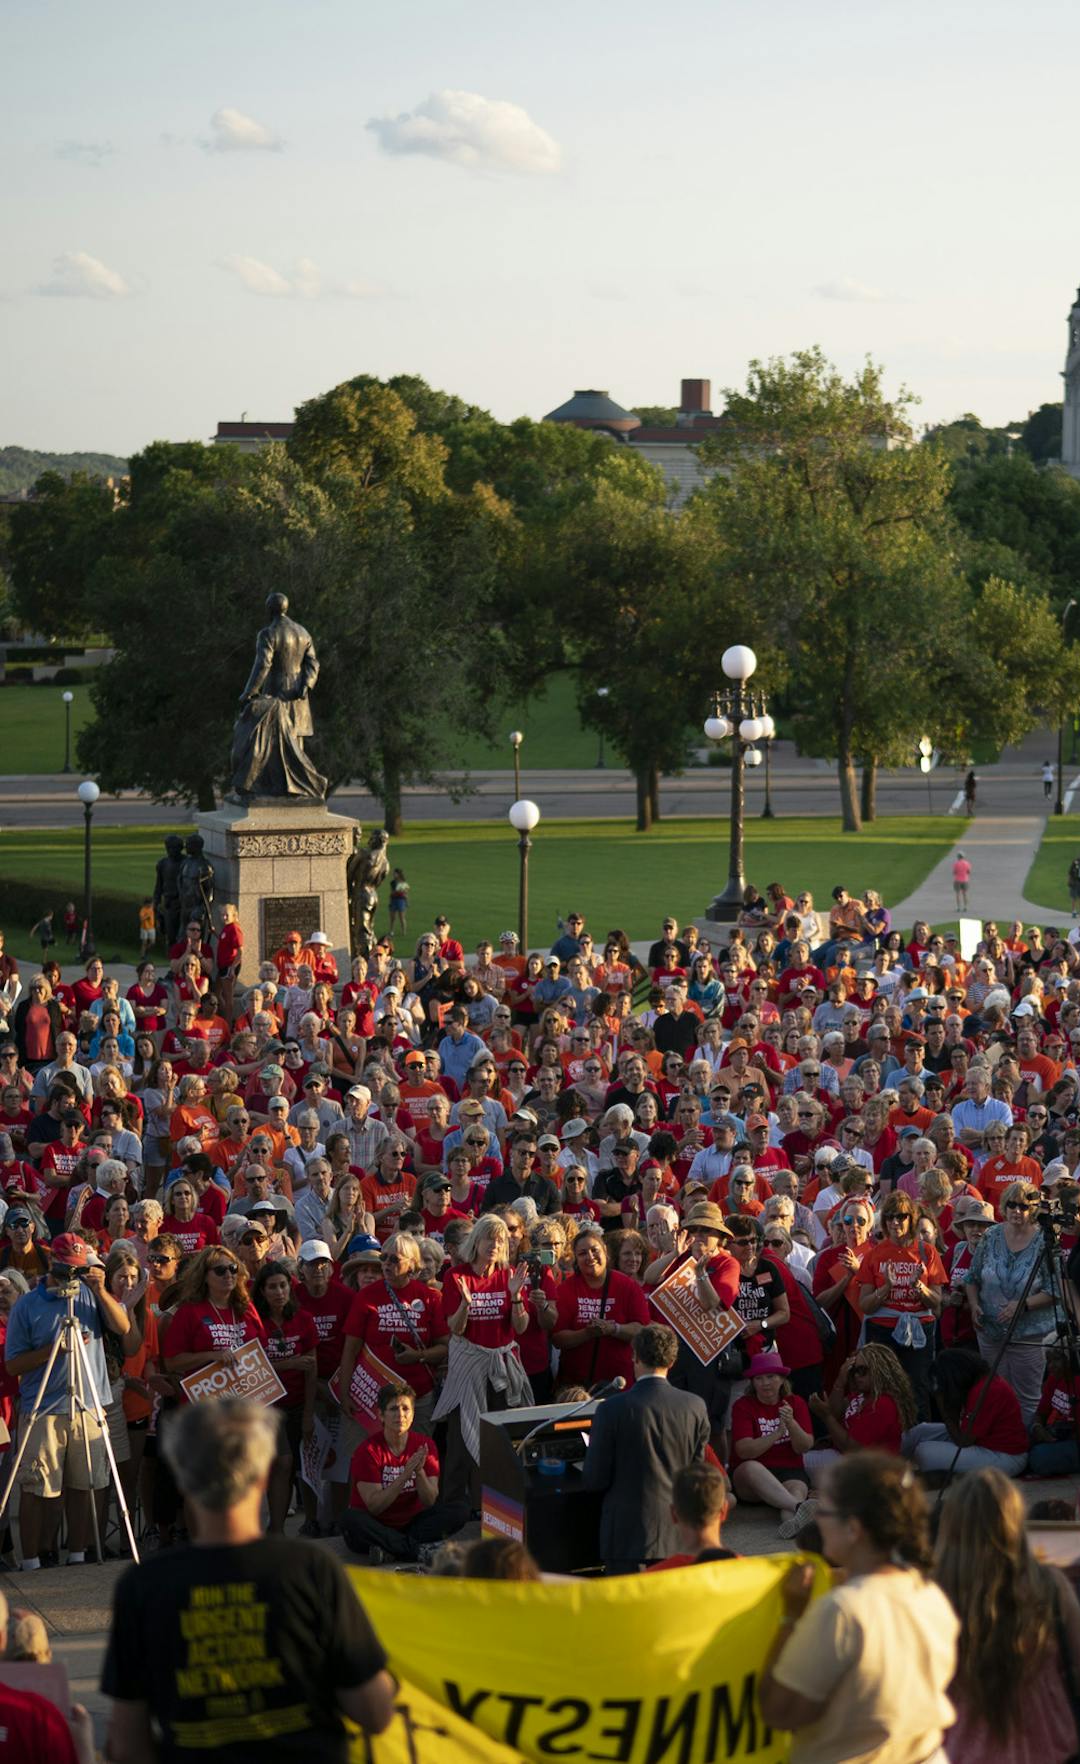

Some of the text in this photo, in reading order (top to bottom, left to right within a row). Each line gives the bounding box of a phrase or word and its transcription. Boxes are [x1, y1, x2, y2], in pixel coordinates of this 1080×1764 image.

[668, 1279, 723, 1348] MINNESOTA
[738, 1299, 758, 1310] GUN
[350, 1383, 375, 1409] CTION
